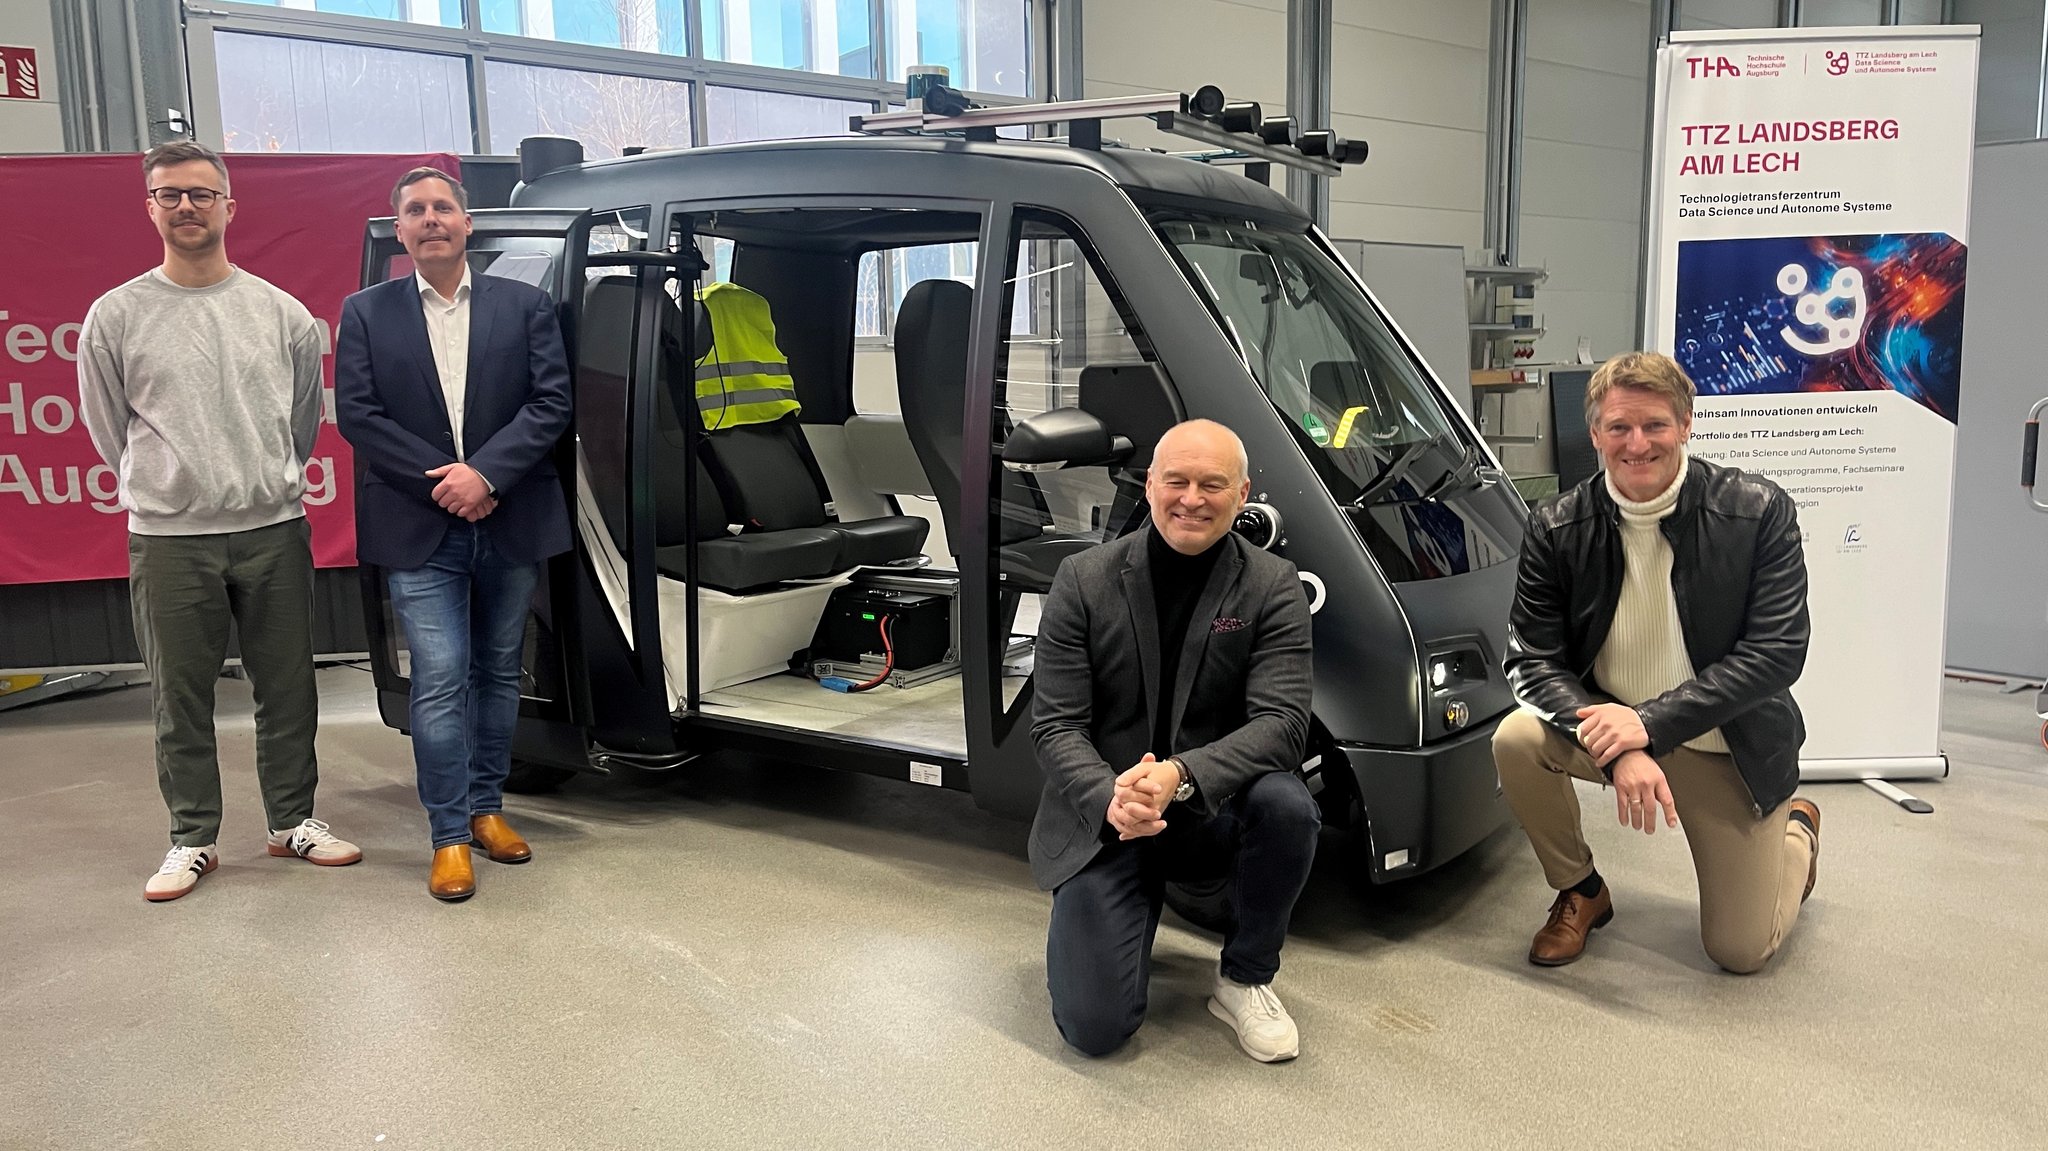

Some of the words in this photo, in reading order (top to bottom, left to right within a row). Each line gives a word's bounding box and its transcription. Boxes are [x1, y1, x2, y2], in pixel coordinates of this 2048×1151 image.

[1681, 125, 1730, 145] TTZ
[1739, 120, 1898, 143] LANDSBERG
[1680, 155, 1723, 175] AM
[1733, 152, 1799, 173] LECH
[1680, 191, 1840, 204] Technologietransferzentrum
[1680, 208, 1705, 217] Data
[1709, 207, 1753, 216] Science
[1757, 205, 1778, 214] und
[1781, 204, 1839, 213] Autonome
[1843, 202, 1892, 213] Systeme
[1694, 409, 1737, 418] einsam
[1741, 407, 1812, 417] Innovationen
[1815, 403, 1879, 415] entwickeln
[1690, 430, 1730, 440] Portfolio
[1751, 430, 1769, 438] TTZ
[1772, 429, 1819, 438] Landsberg
[1822, 429, 1837, 437] am
[1839, 427, 1865, 437] Lech:
[1730, 450, 1749, 458] Data
[1753, 449, 1788, 457] Science
[1808, 447, 1857, 456] Autonome
[1859, 446, 1896, 455] Systeme
[1842, 464, 1905, 474] Fachseminare
[1796, 500, 1819, 509] egion
